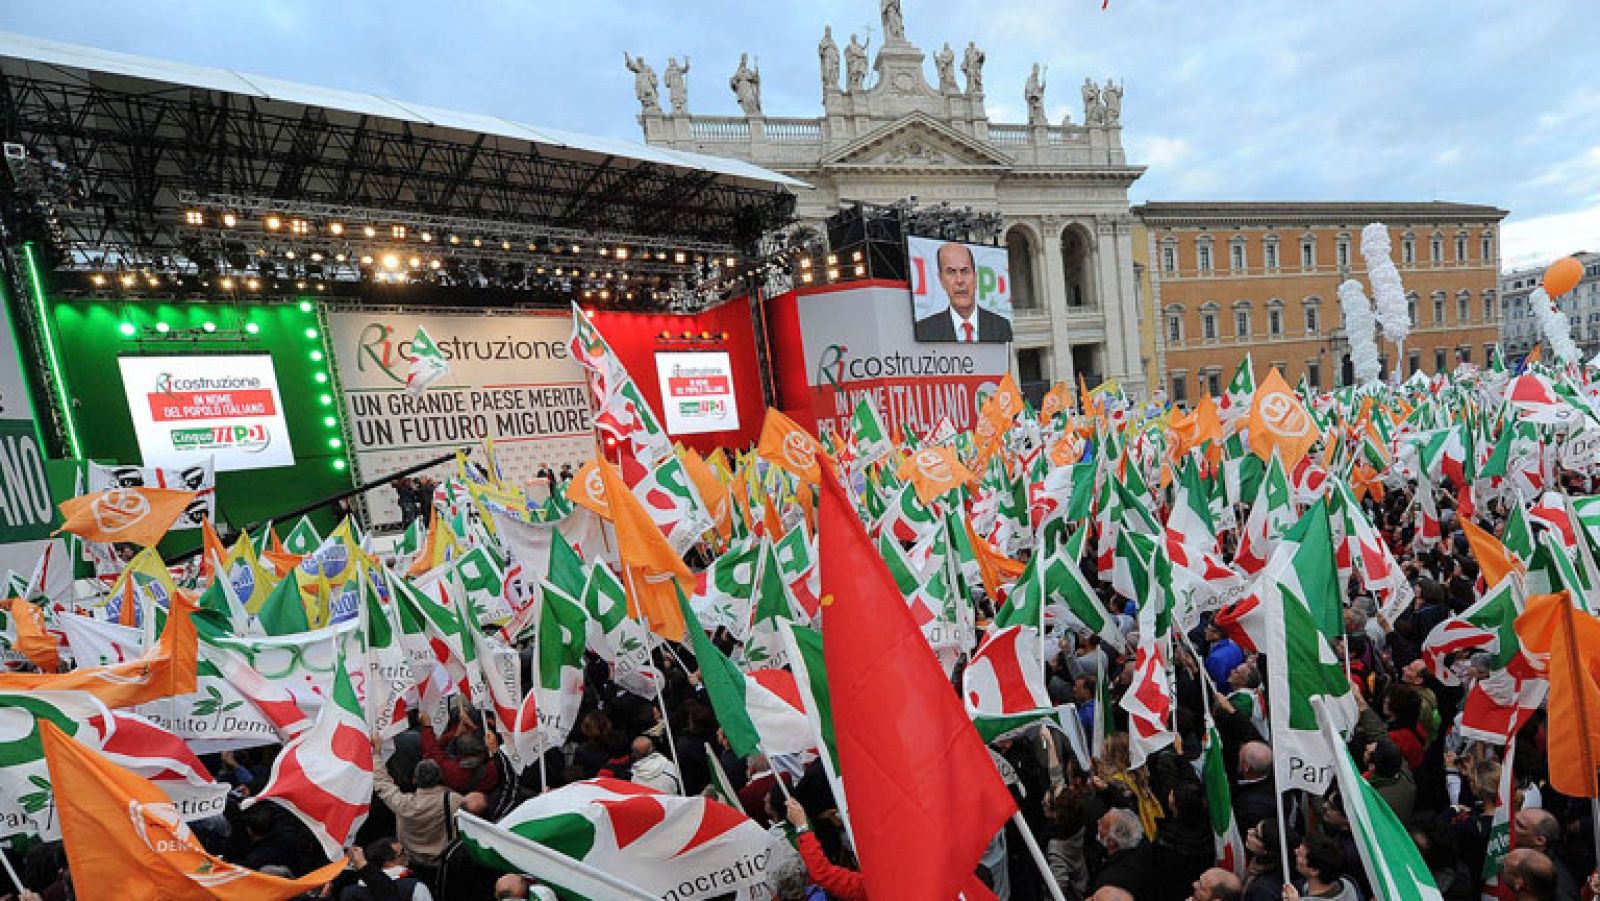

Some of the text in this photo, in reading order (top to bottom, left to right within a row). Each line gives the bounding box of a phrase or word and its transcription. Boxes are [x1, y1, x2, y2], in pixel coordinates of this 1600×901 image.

[351, 386, 587, 416] UN GRANDE PAESE MERITA
[888, 382, 971, 438] ITALIANO
[356, 407, 593, 447] UN FUTURO MIGLIORE
